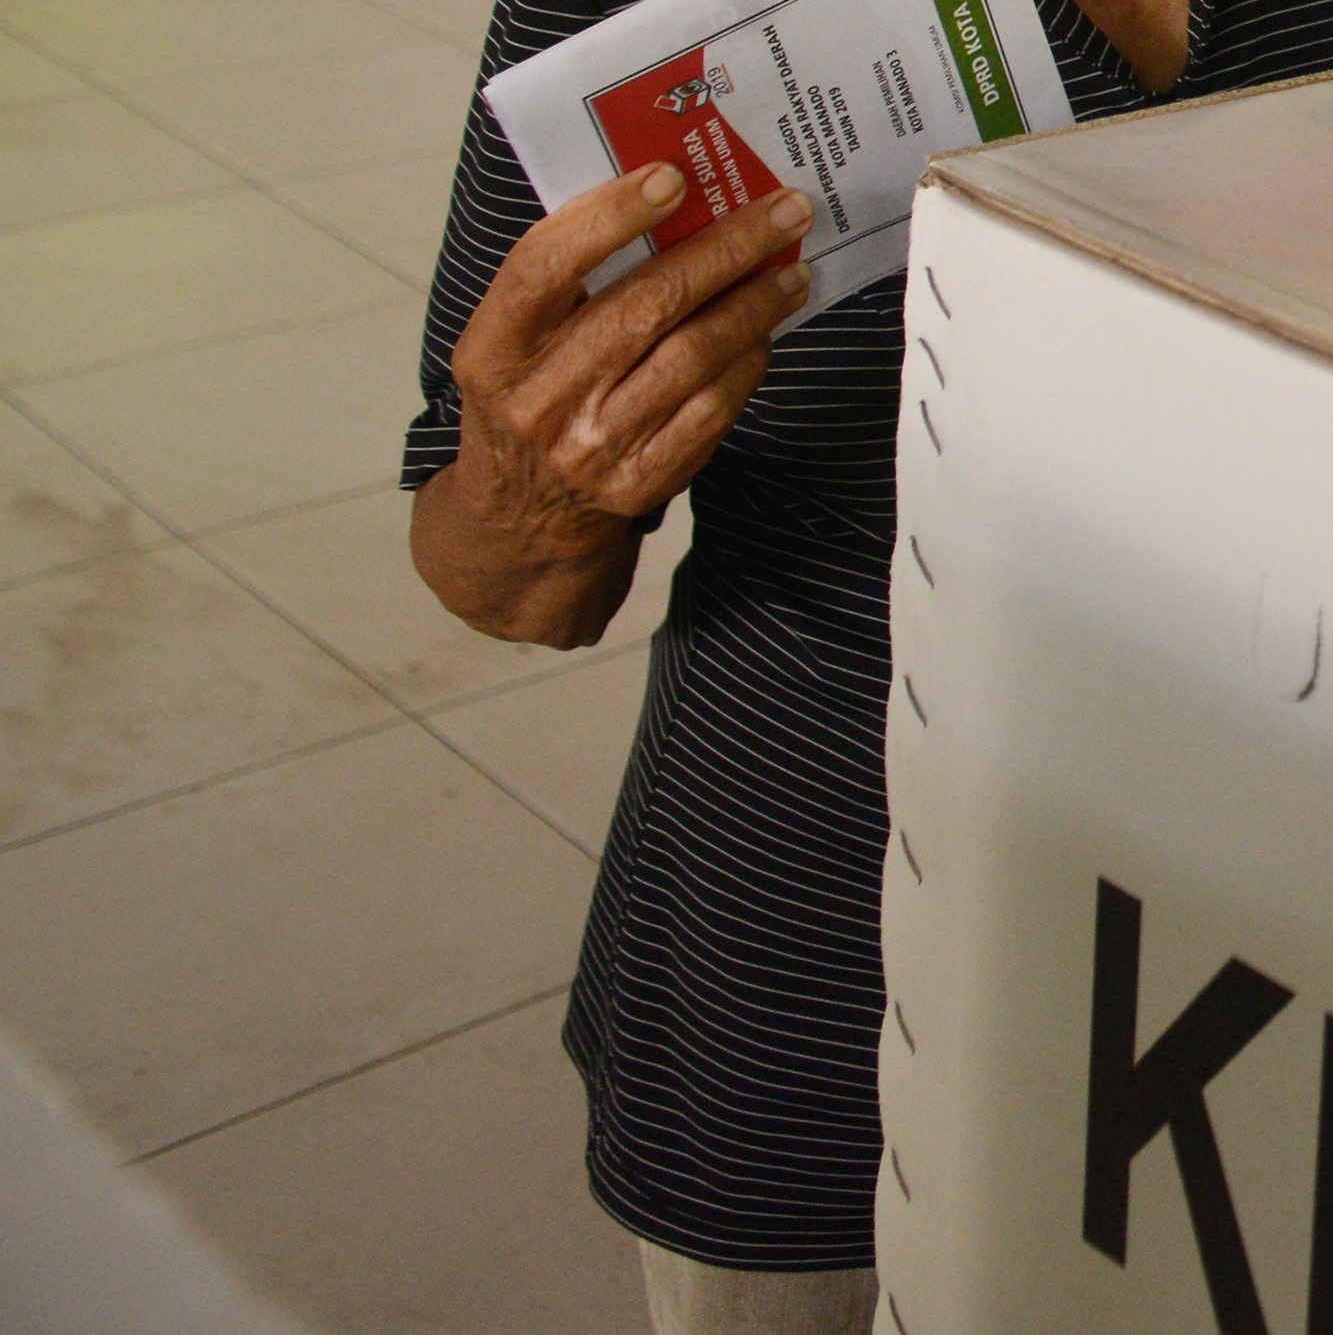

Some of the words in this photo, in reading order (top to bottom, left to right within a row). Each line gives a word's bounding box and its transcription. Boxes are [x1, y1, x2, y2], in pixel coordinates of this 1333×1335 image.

[928, 25, 942, 50] UMUM
[953, 1, 982, 55] KOTA
[763, 24, 793, 79] DAERAH
[886, 49, 897, 59] 3
[937, 51, 956, 88] PEMILIHAN
[707, 67, 729, 98] 2019
[783, 78, 809, 124] RAKYAT
[828, 87, 847, 116] 2019
[872, 60, 897, 105] PEMILIHAN
[890, 59, 917, 106] MANADO
[950, 89, 965, 113] KOMISI
[971, 56, 1000, 107] DPRD
[807, 85, 836, 138] MANADO
[888, 107, 907, 138] DAERAH
[907, 106, 924, 134] KOTA
[706, 118, 733, 160] UMUM
[777, 114, 806, 168] ANGGOTA
[826, 137, 846, 169] KOTA
[839, 114, 861, 153] TAHUN
[683, 129, 717, 186] SUARA
[800, 123, 836, 194] PERWAKILAN
[723, 158, 750, 206] MILIHAN
[703, 187, 729, 220] RAT
[826, 194, 850, 234] DEWAN
